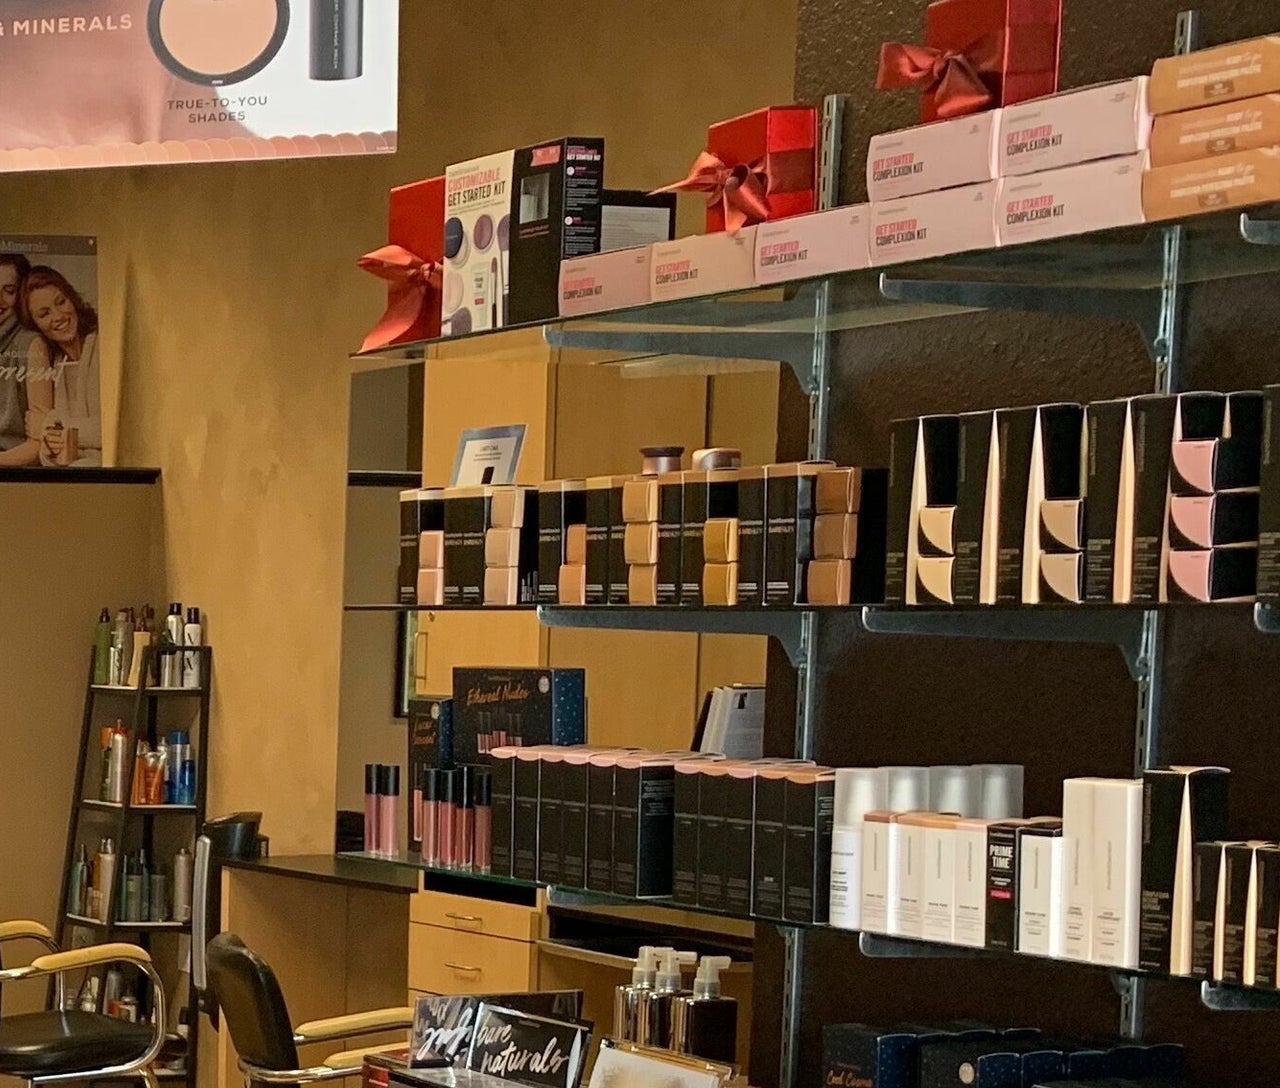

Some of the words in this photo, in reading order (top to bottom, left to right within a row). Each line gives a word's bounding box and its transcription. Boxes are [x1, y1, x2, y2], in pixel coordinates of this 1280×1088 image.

[13, 13, 133, 35] MINERALS
[167, 95, 268, 111] TRUE-TO-YOU
[188, 110, 246, 124] SHADES
[1006, 137, 1050, 157] COMPLEXION
[1051, 134, 1063, 145] KIT
[448, 168, 501, 192] CUSTOMIZABLE
[873, 164, 913, 182] COMPLEXION
[913, 161, 924, 173] KIT
[448, 191, 461, 207] GET
[463, 184, 491, 204] STARTED
[493, 181, 506, 196] KIT
[1006, 207, 1052, 225] COMPLEXION
[1052, 204, 1065, 215] KIT
[875, 230, 915, 247] COMPLEXION
[916, 228, 927, 239] KIT
[990, 845, 1014, 858] PRIME
[992, 856, 1011, 869] TIME
[477, 1023, 512, 1048] bare
[480, 1036, 570, 1076] naturals
